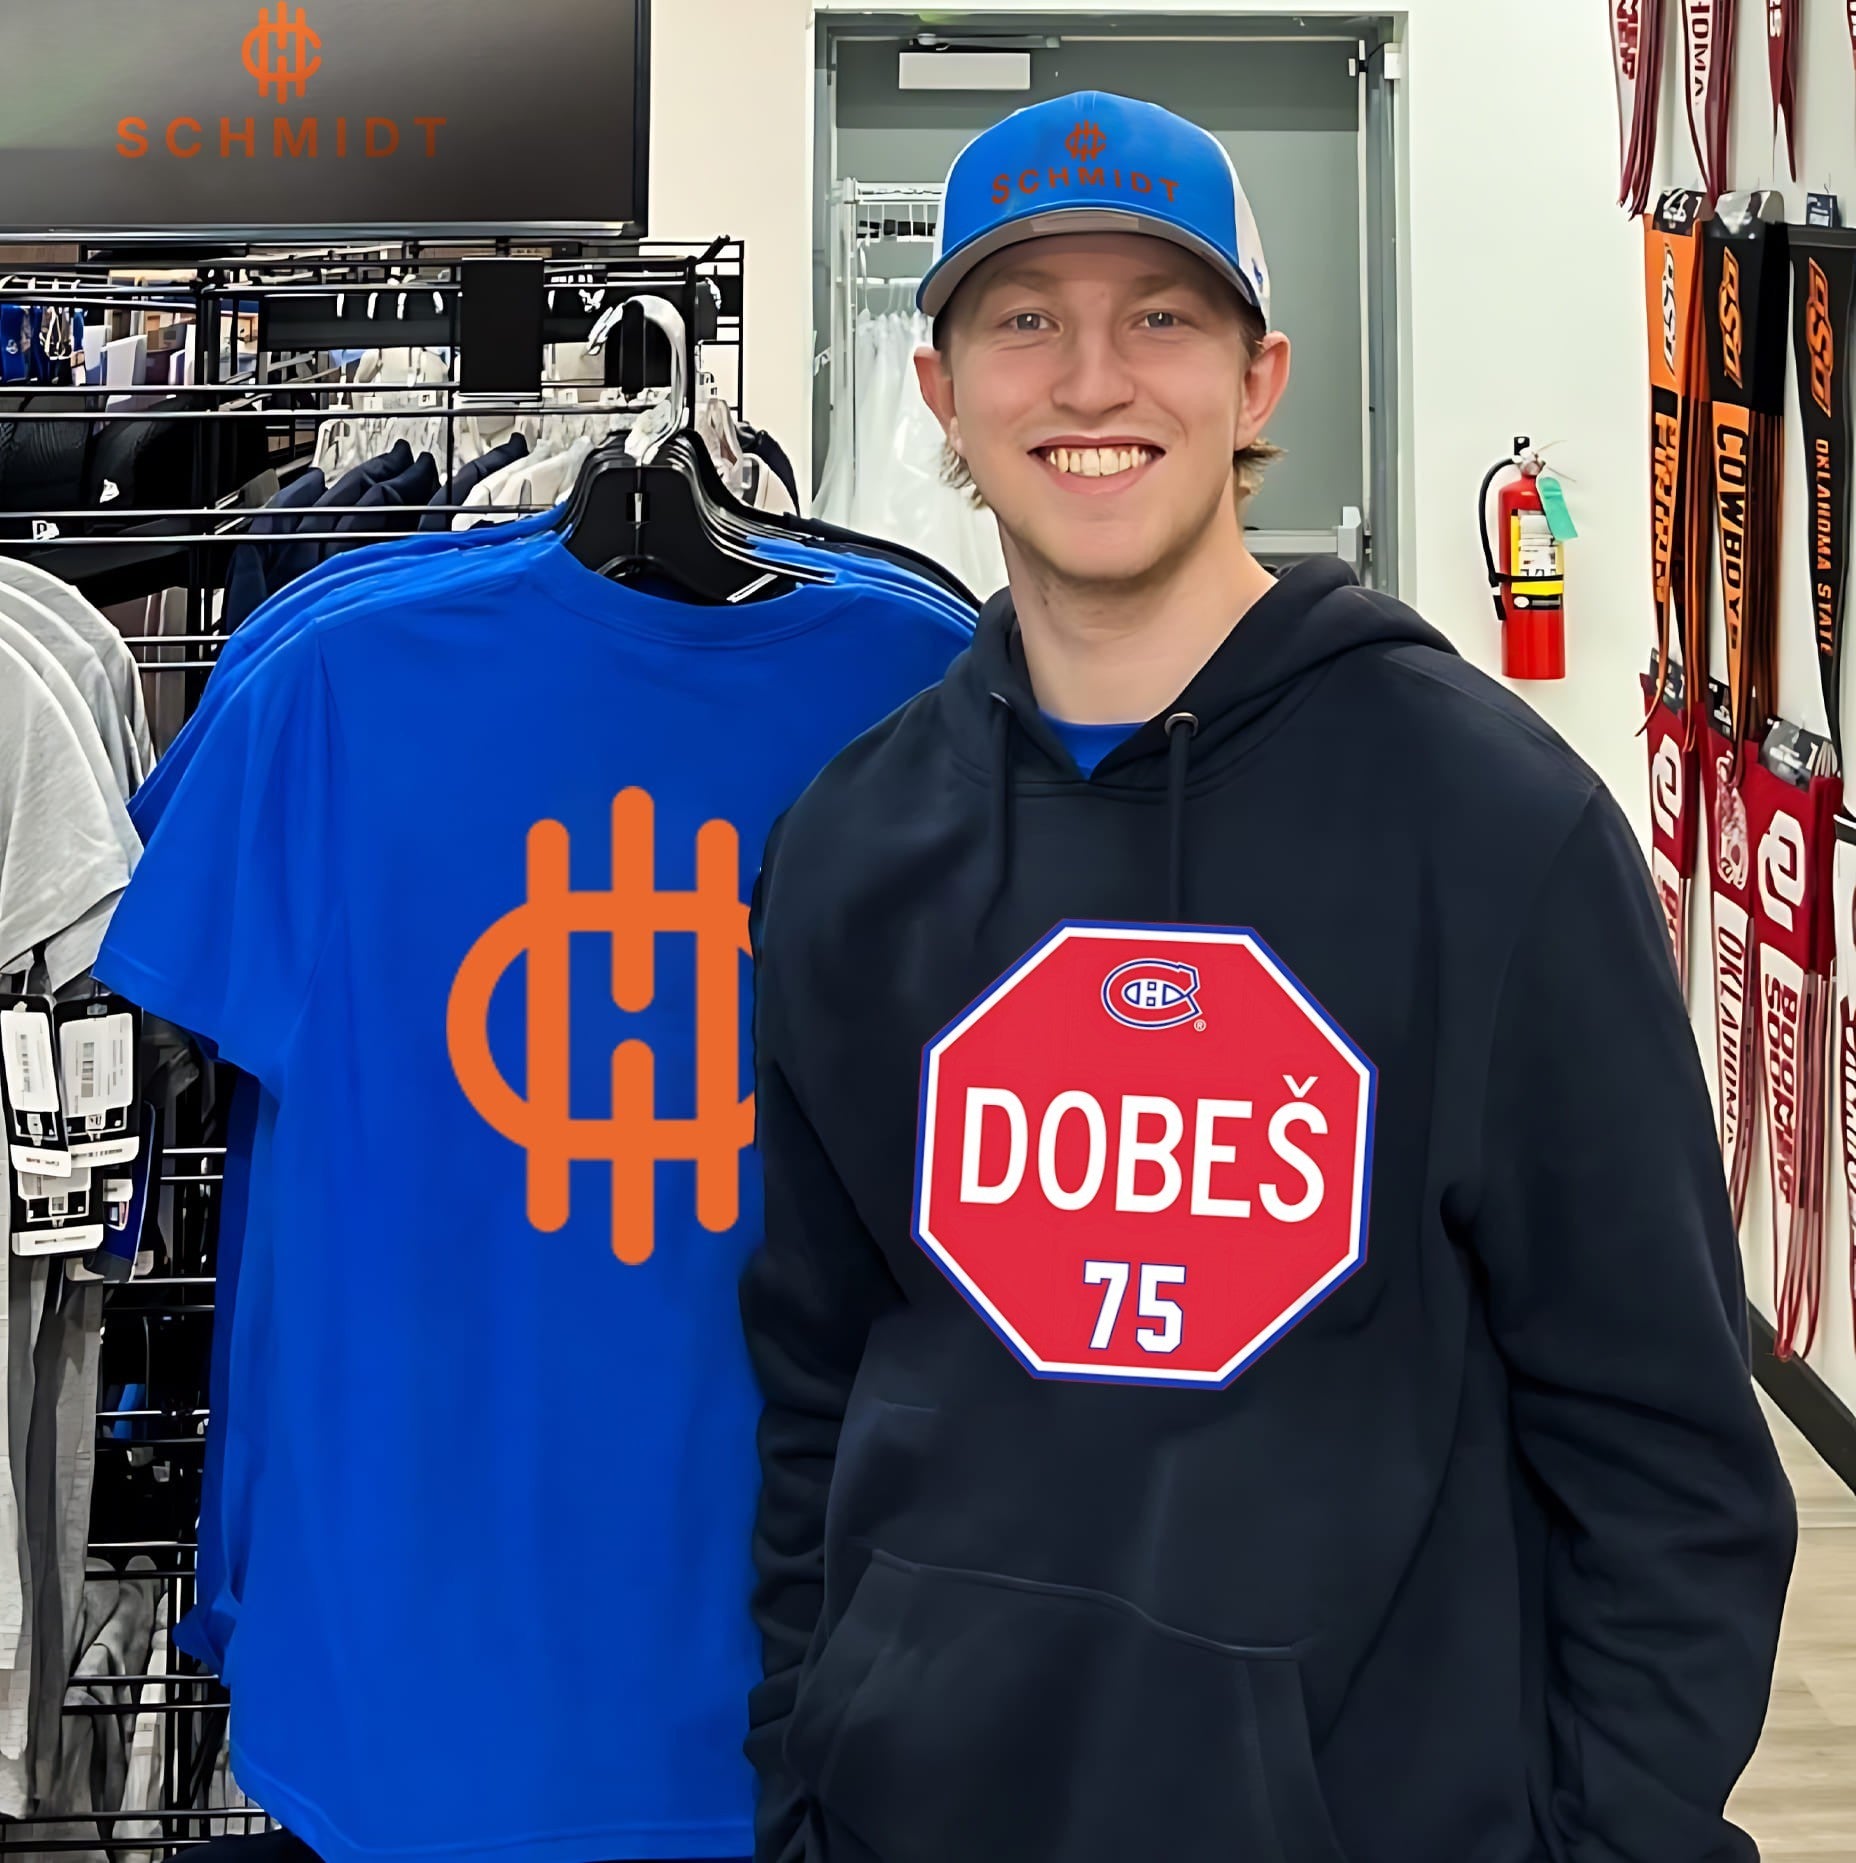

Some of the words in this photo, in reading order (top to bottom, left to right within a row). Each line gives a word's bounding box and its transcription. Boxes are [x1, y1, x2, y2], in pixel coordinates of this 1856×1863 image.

[115, 116, 448, 159] SCHMIDT
[991, 167, 1180, 204] SCHMIDT
[960, 1074, 1328, 1223] DOBEŠ
[1083, 1260, 1187, 1353] 75
